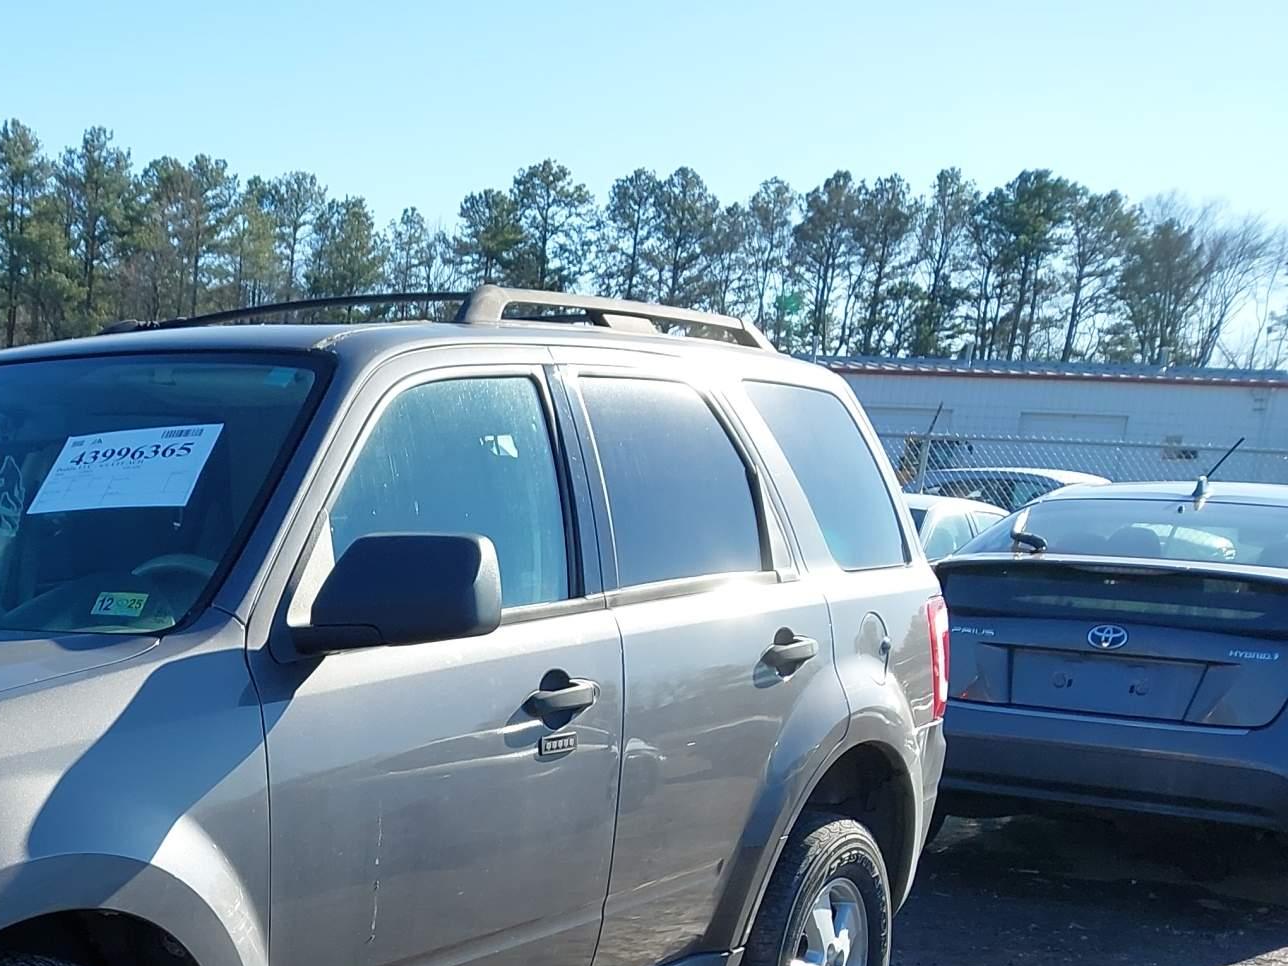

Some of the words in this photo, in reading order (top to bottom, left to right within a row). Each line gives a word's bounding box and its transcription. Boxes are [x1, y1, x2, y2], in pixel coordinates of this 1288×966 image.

[70, 442, 194, 466] 43996365
[98, 597, 114, 611] 12
[128, 598, 143, 609] 25
